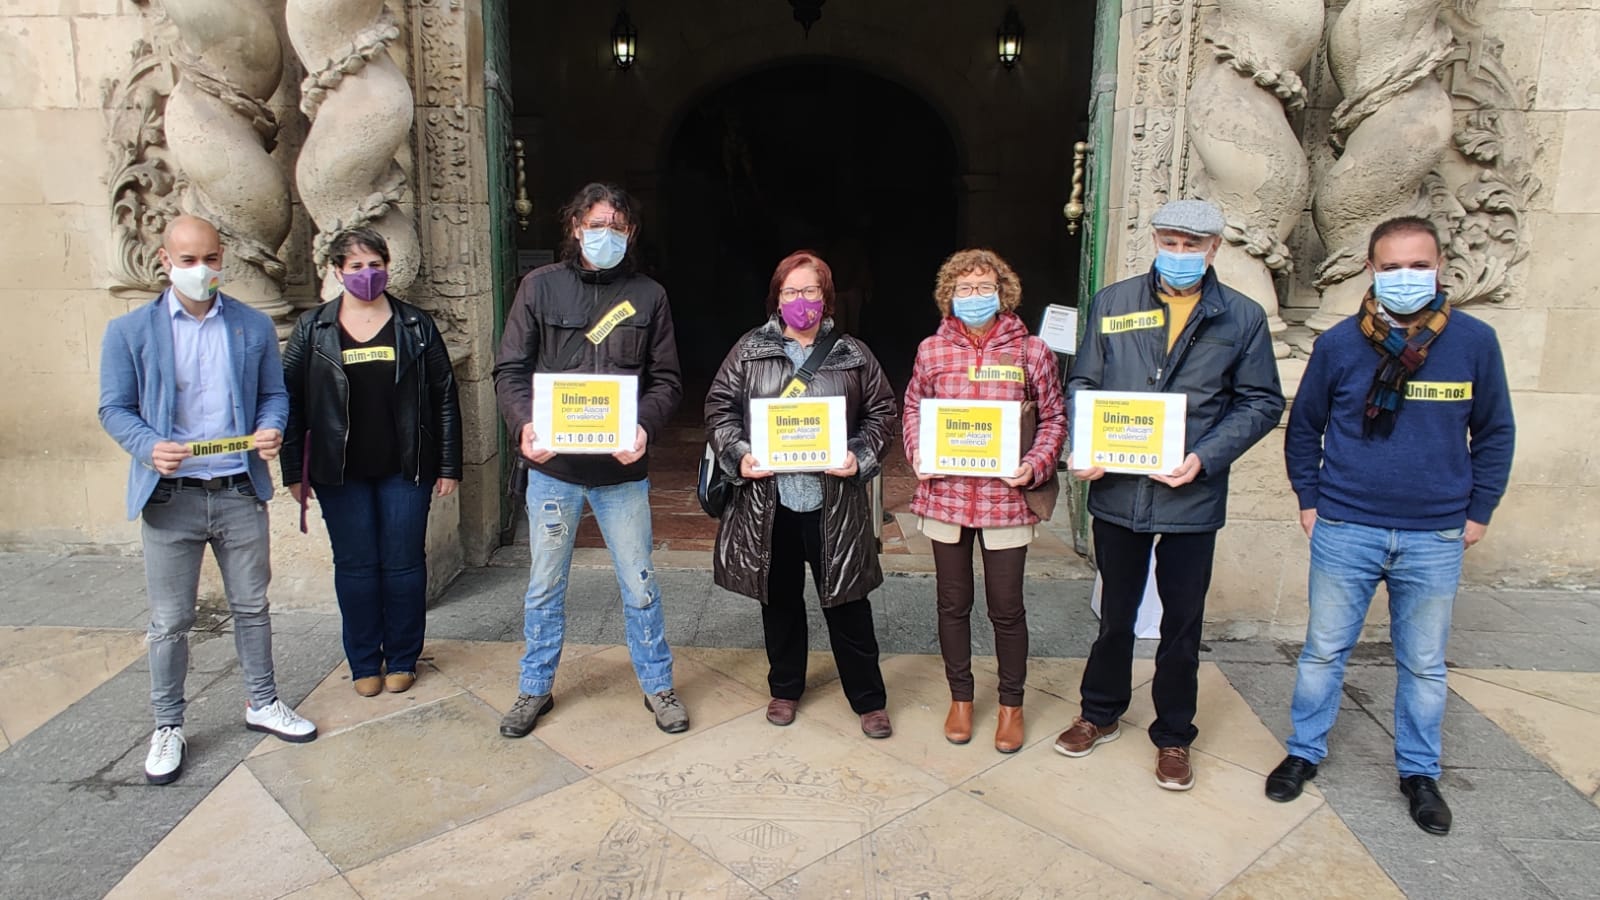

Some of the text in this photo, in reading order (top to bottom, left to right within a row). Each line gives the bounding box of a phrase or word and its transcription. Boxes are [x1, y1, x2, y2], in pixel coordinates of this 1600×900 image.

[591, 308, 629, 343] Unim-nos
[1110, 315, 1158, 331] Unim-nos
[974, 367, 1022, 381] Unim-nos
[1406, 383, 1466, 399] Unim-nos
[561, 393, 610, 406] Unim-nos
[776, 415, 821, 426] Unim-nos
[945, 418, 993, 431] Unim-nos
[1103, 411, 1155, 426] Unim-nos
[192, 440, 249, 456] Unim-nos
